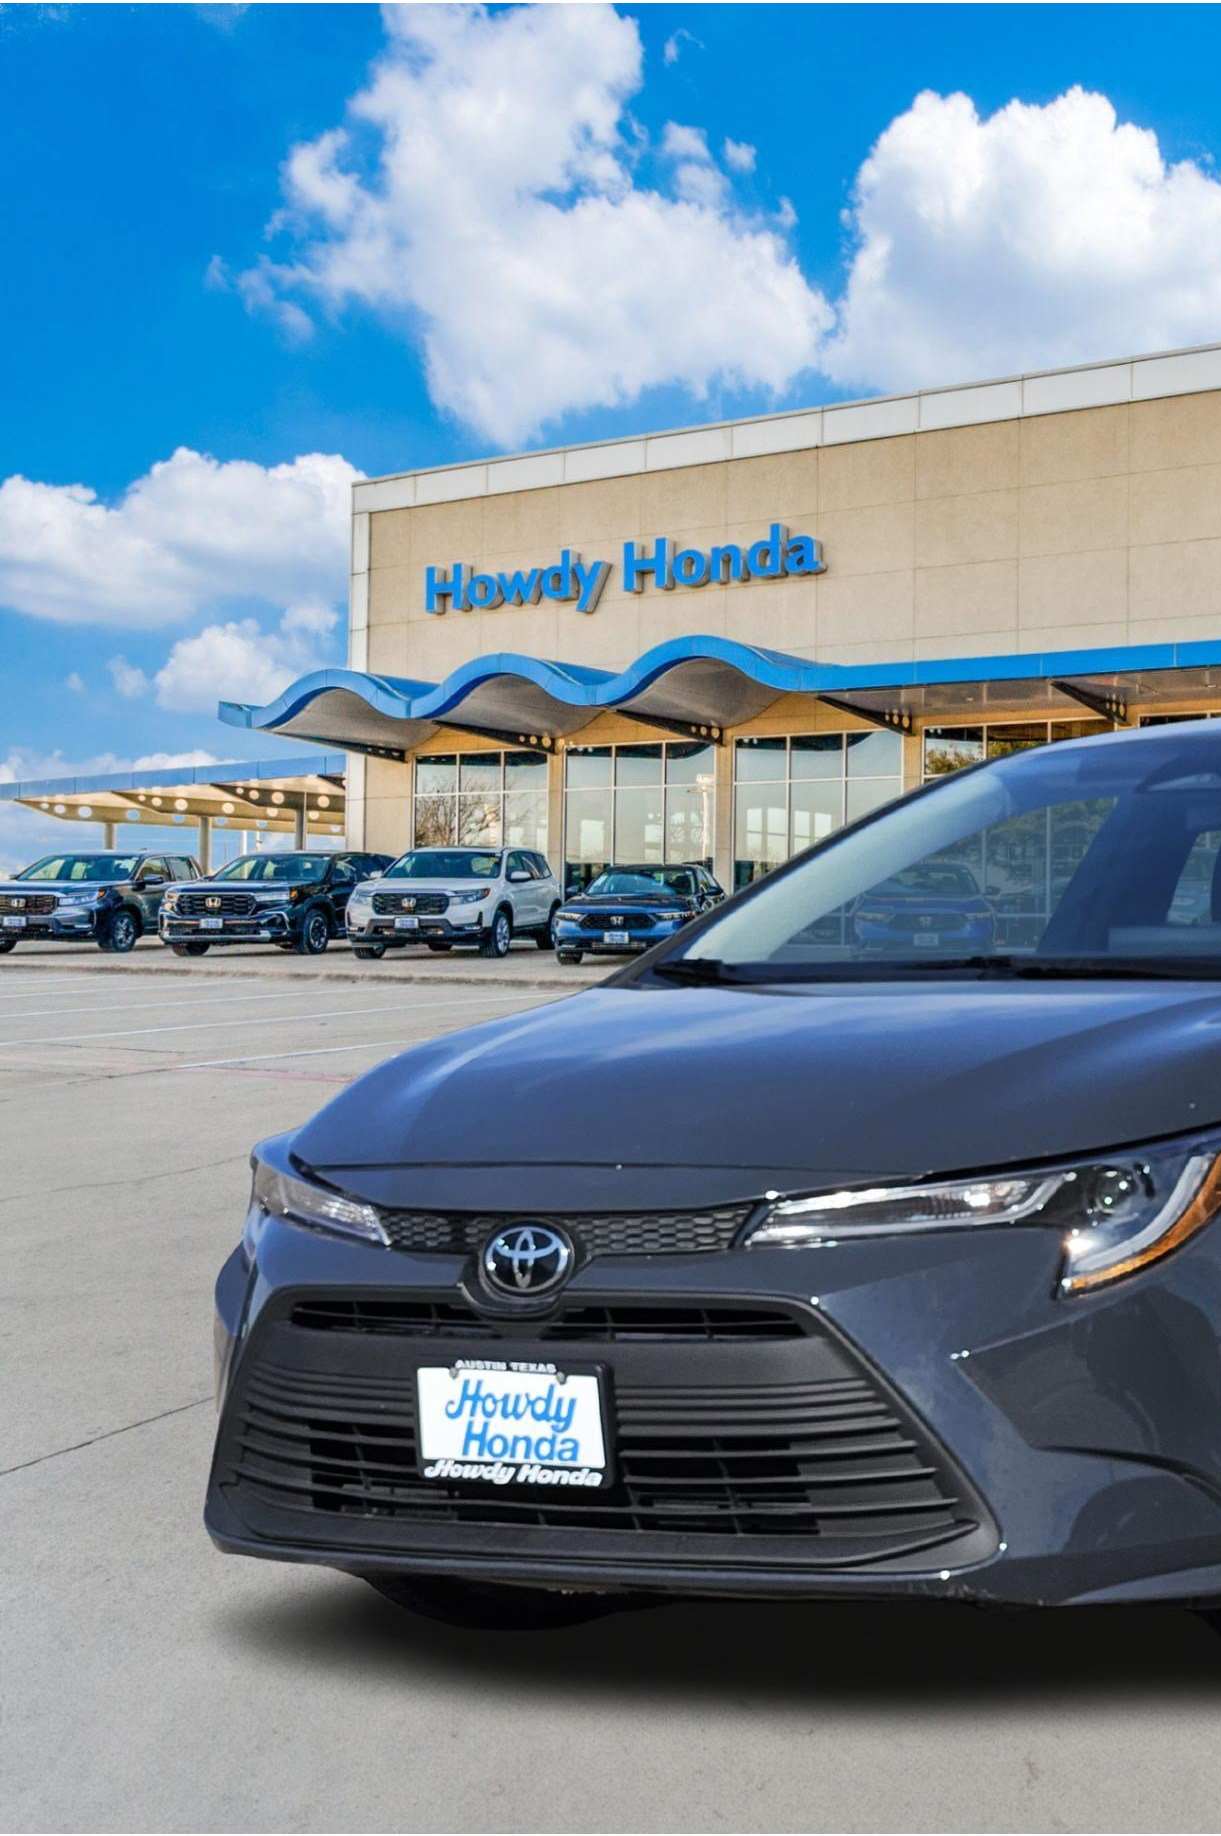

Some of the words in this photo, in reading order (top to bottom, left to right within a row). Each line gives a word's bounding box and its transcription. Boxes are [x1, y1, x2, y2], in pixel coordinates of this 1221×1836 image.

[425, 548, 612, 614] Howdy
[623, 523, 826, 594] Honda
[455, 1359, 507, 1371] AUSTIN
[509, 1361, 557, 1374] TEXAS
[445, 1378, 578, 1433] Howdy
[461, 1420, 580, 1462] Honda
[424, 1459, 516, 1485] Howdy
[516, 1463, 603, 1487] Honda
